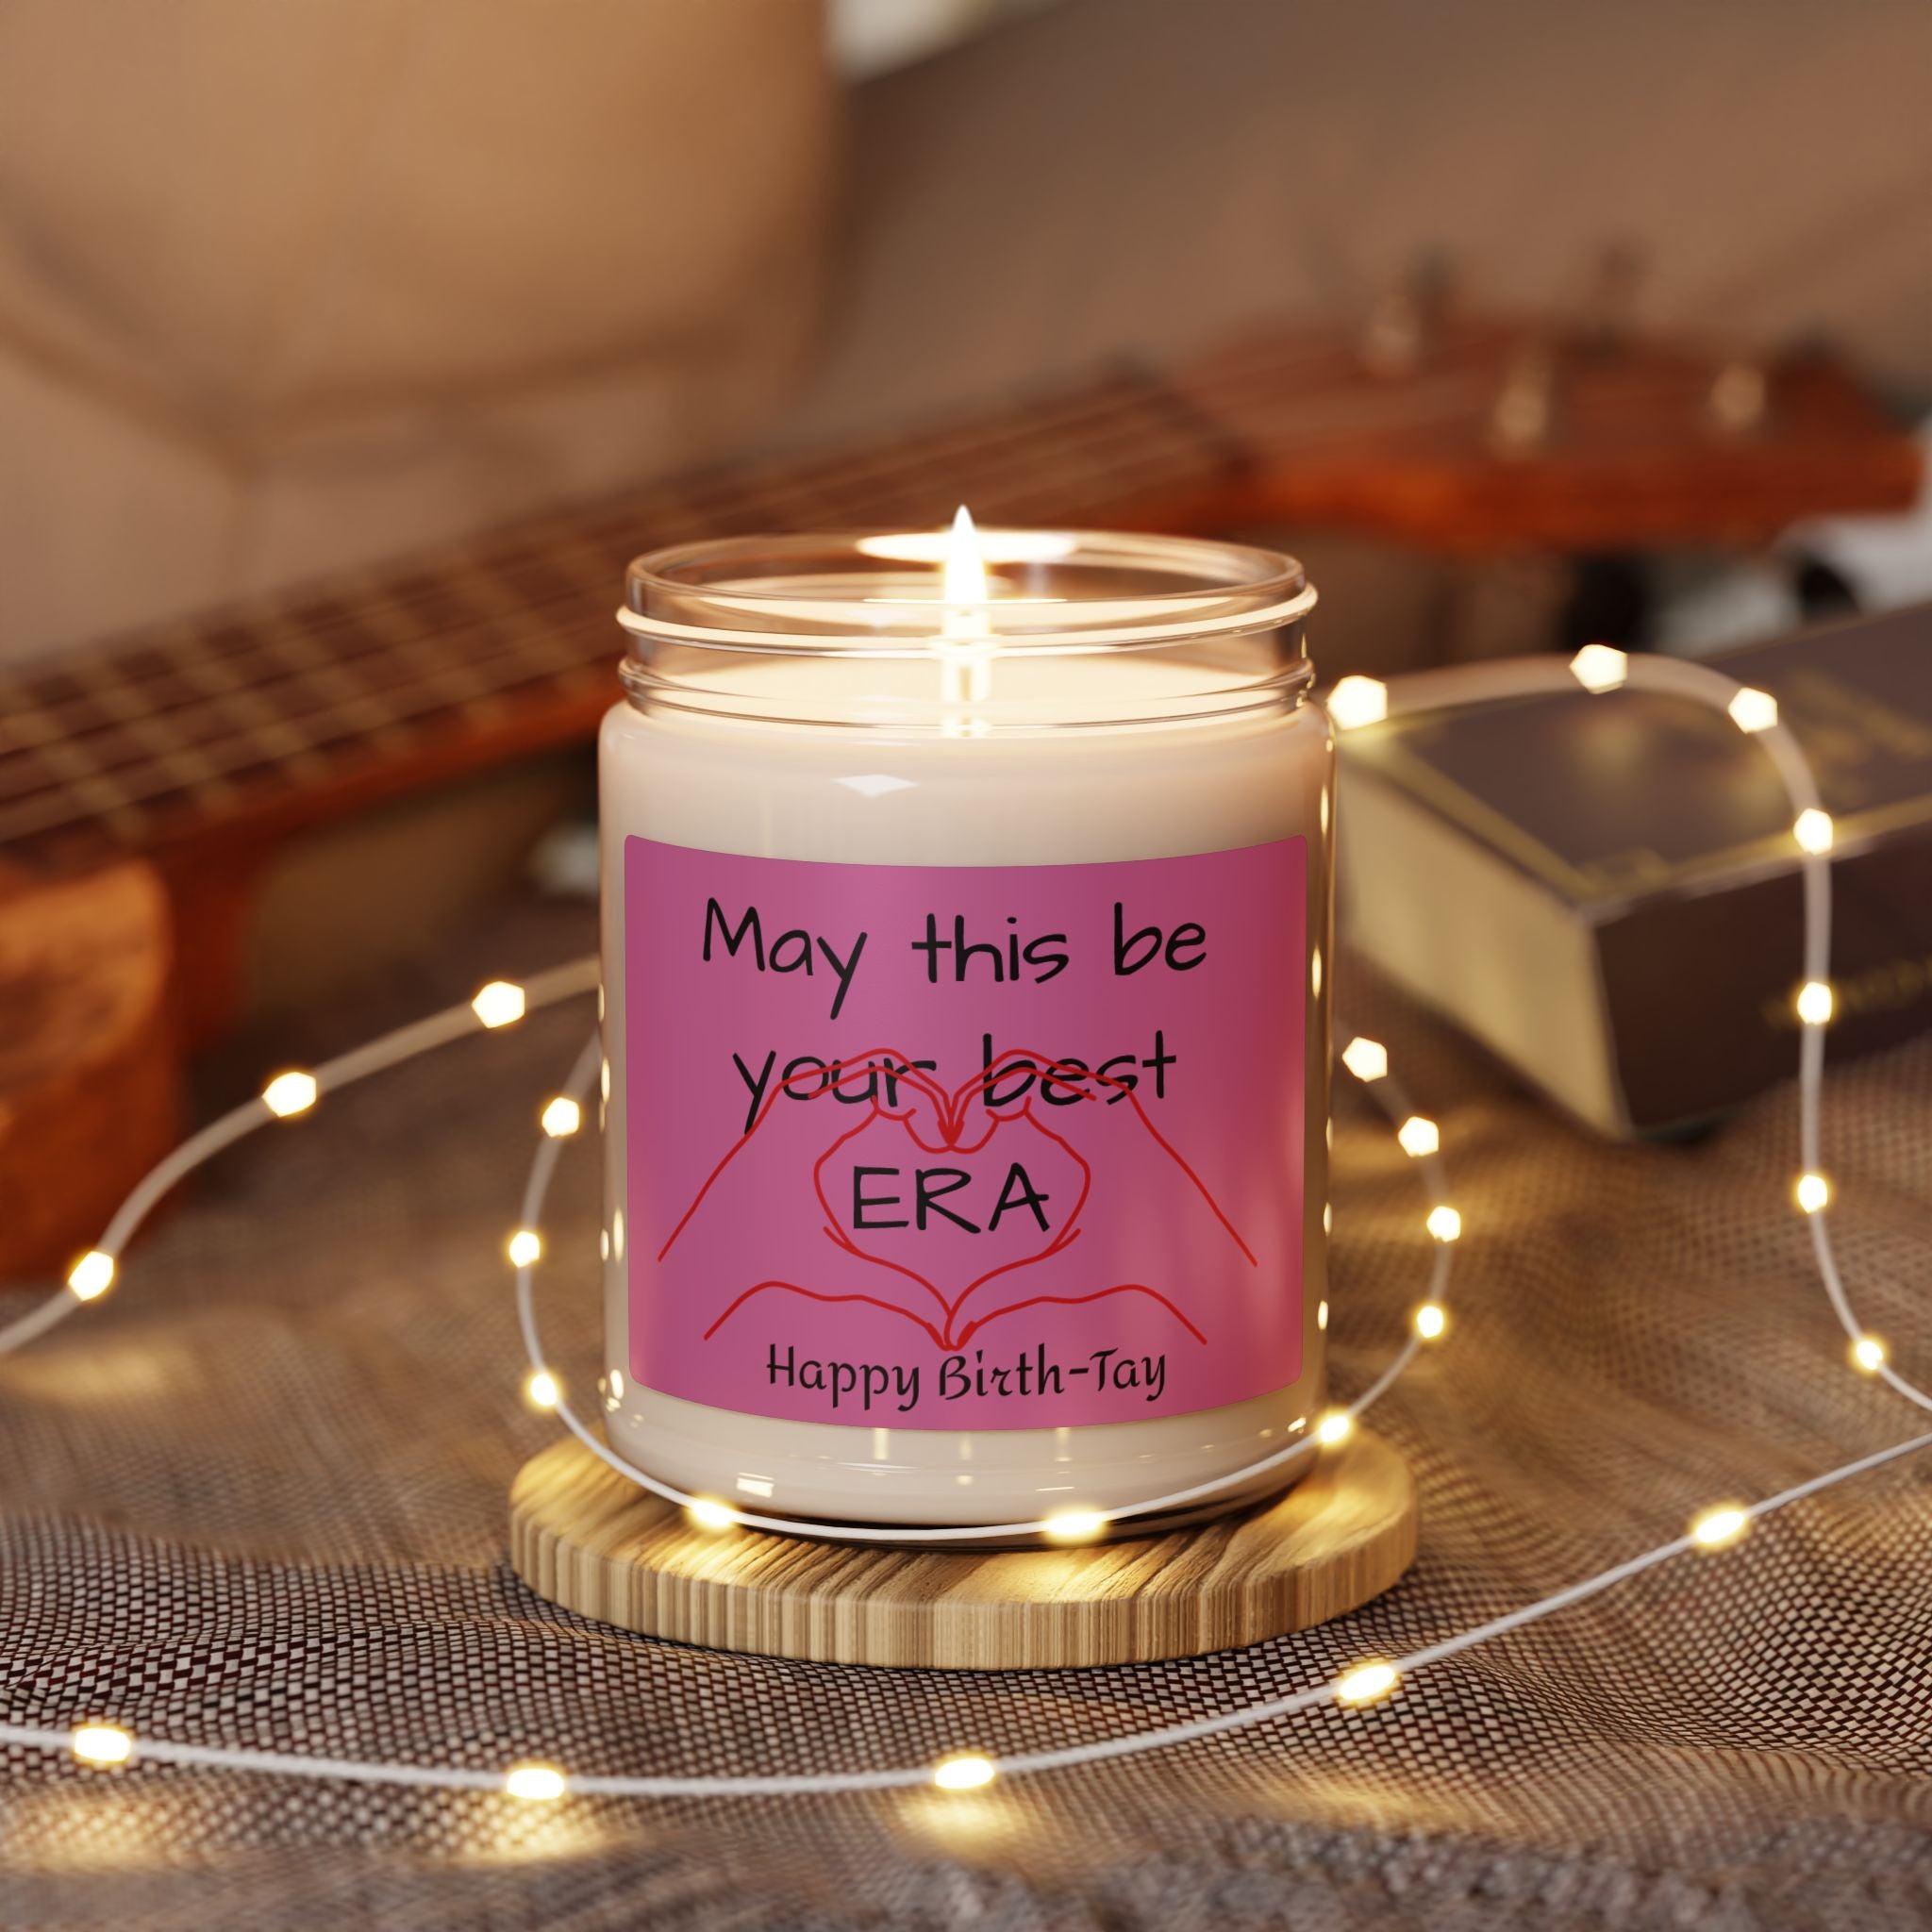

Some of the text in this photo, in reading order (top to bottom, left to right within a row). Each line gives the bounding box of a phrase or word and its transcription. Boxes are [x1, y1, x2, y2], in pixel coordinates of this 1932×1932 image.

[703, 897, 1208, 1021] May this be
[732, 1029, 1177, 1135] your best
[853, 1161, 1050, 1235] ERA
[766, 1342, 1165, 1412] Happy Birth-Tay
